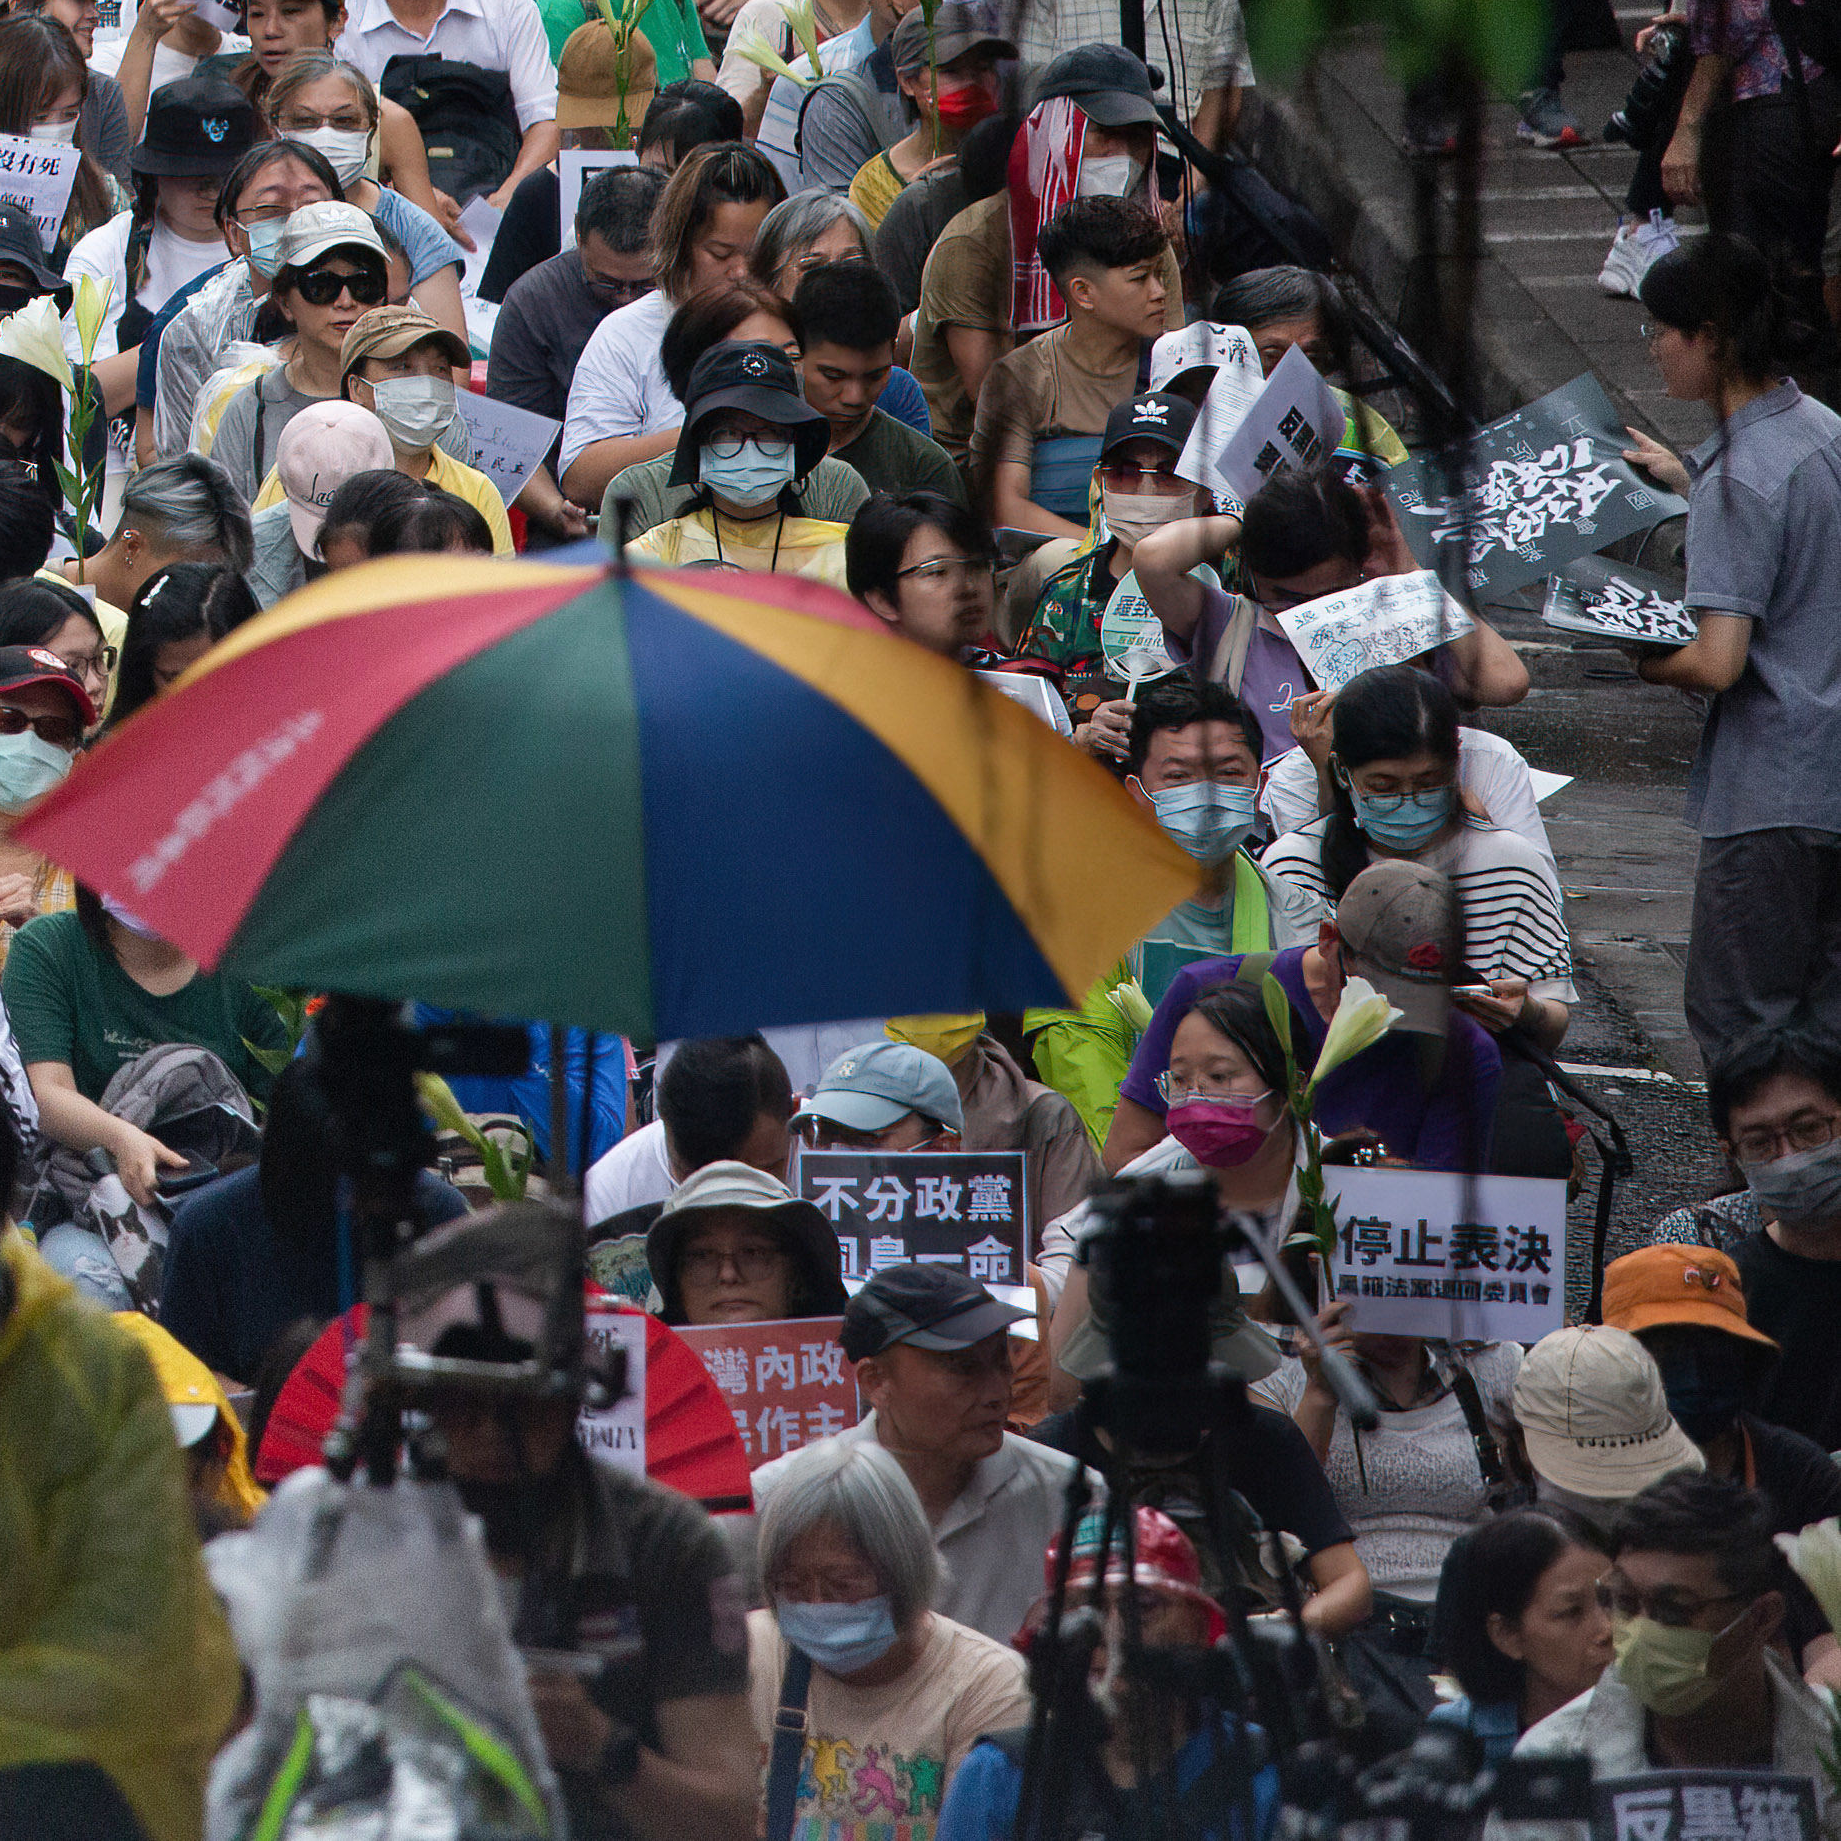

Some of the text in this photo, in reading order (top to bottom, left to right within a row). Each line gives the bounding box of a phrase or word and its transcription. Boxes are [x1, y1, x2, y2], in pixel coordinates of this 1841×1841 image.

[811, 1174, 1013, 1222] 不分政黨
[1337, 1215, 1553, 1276] 停止表決
